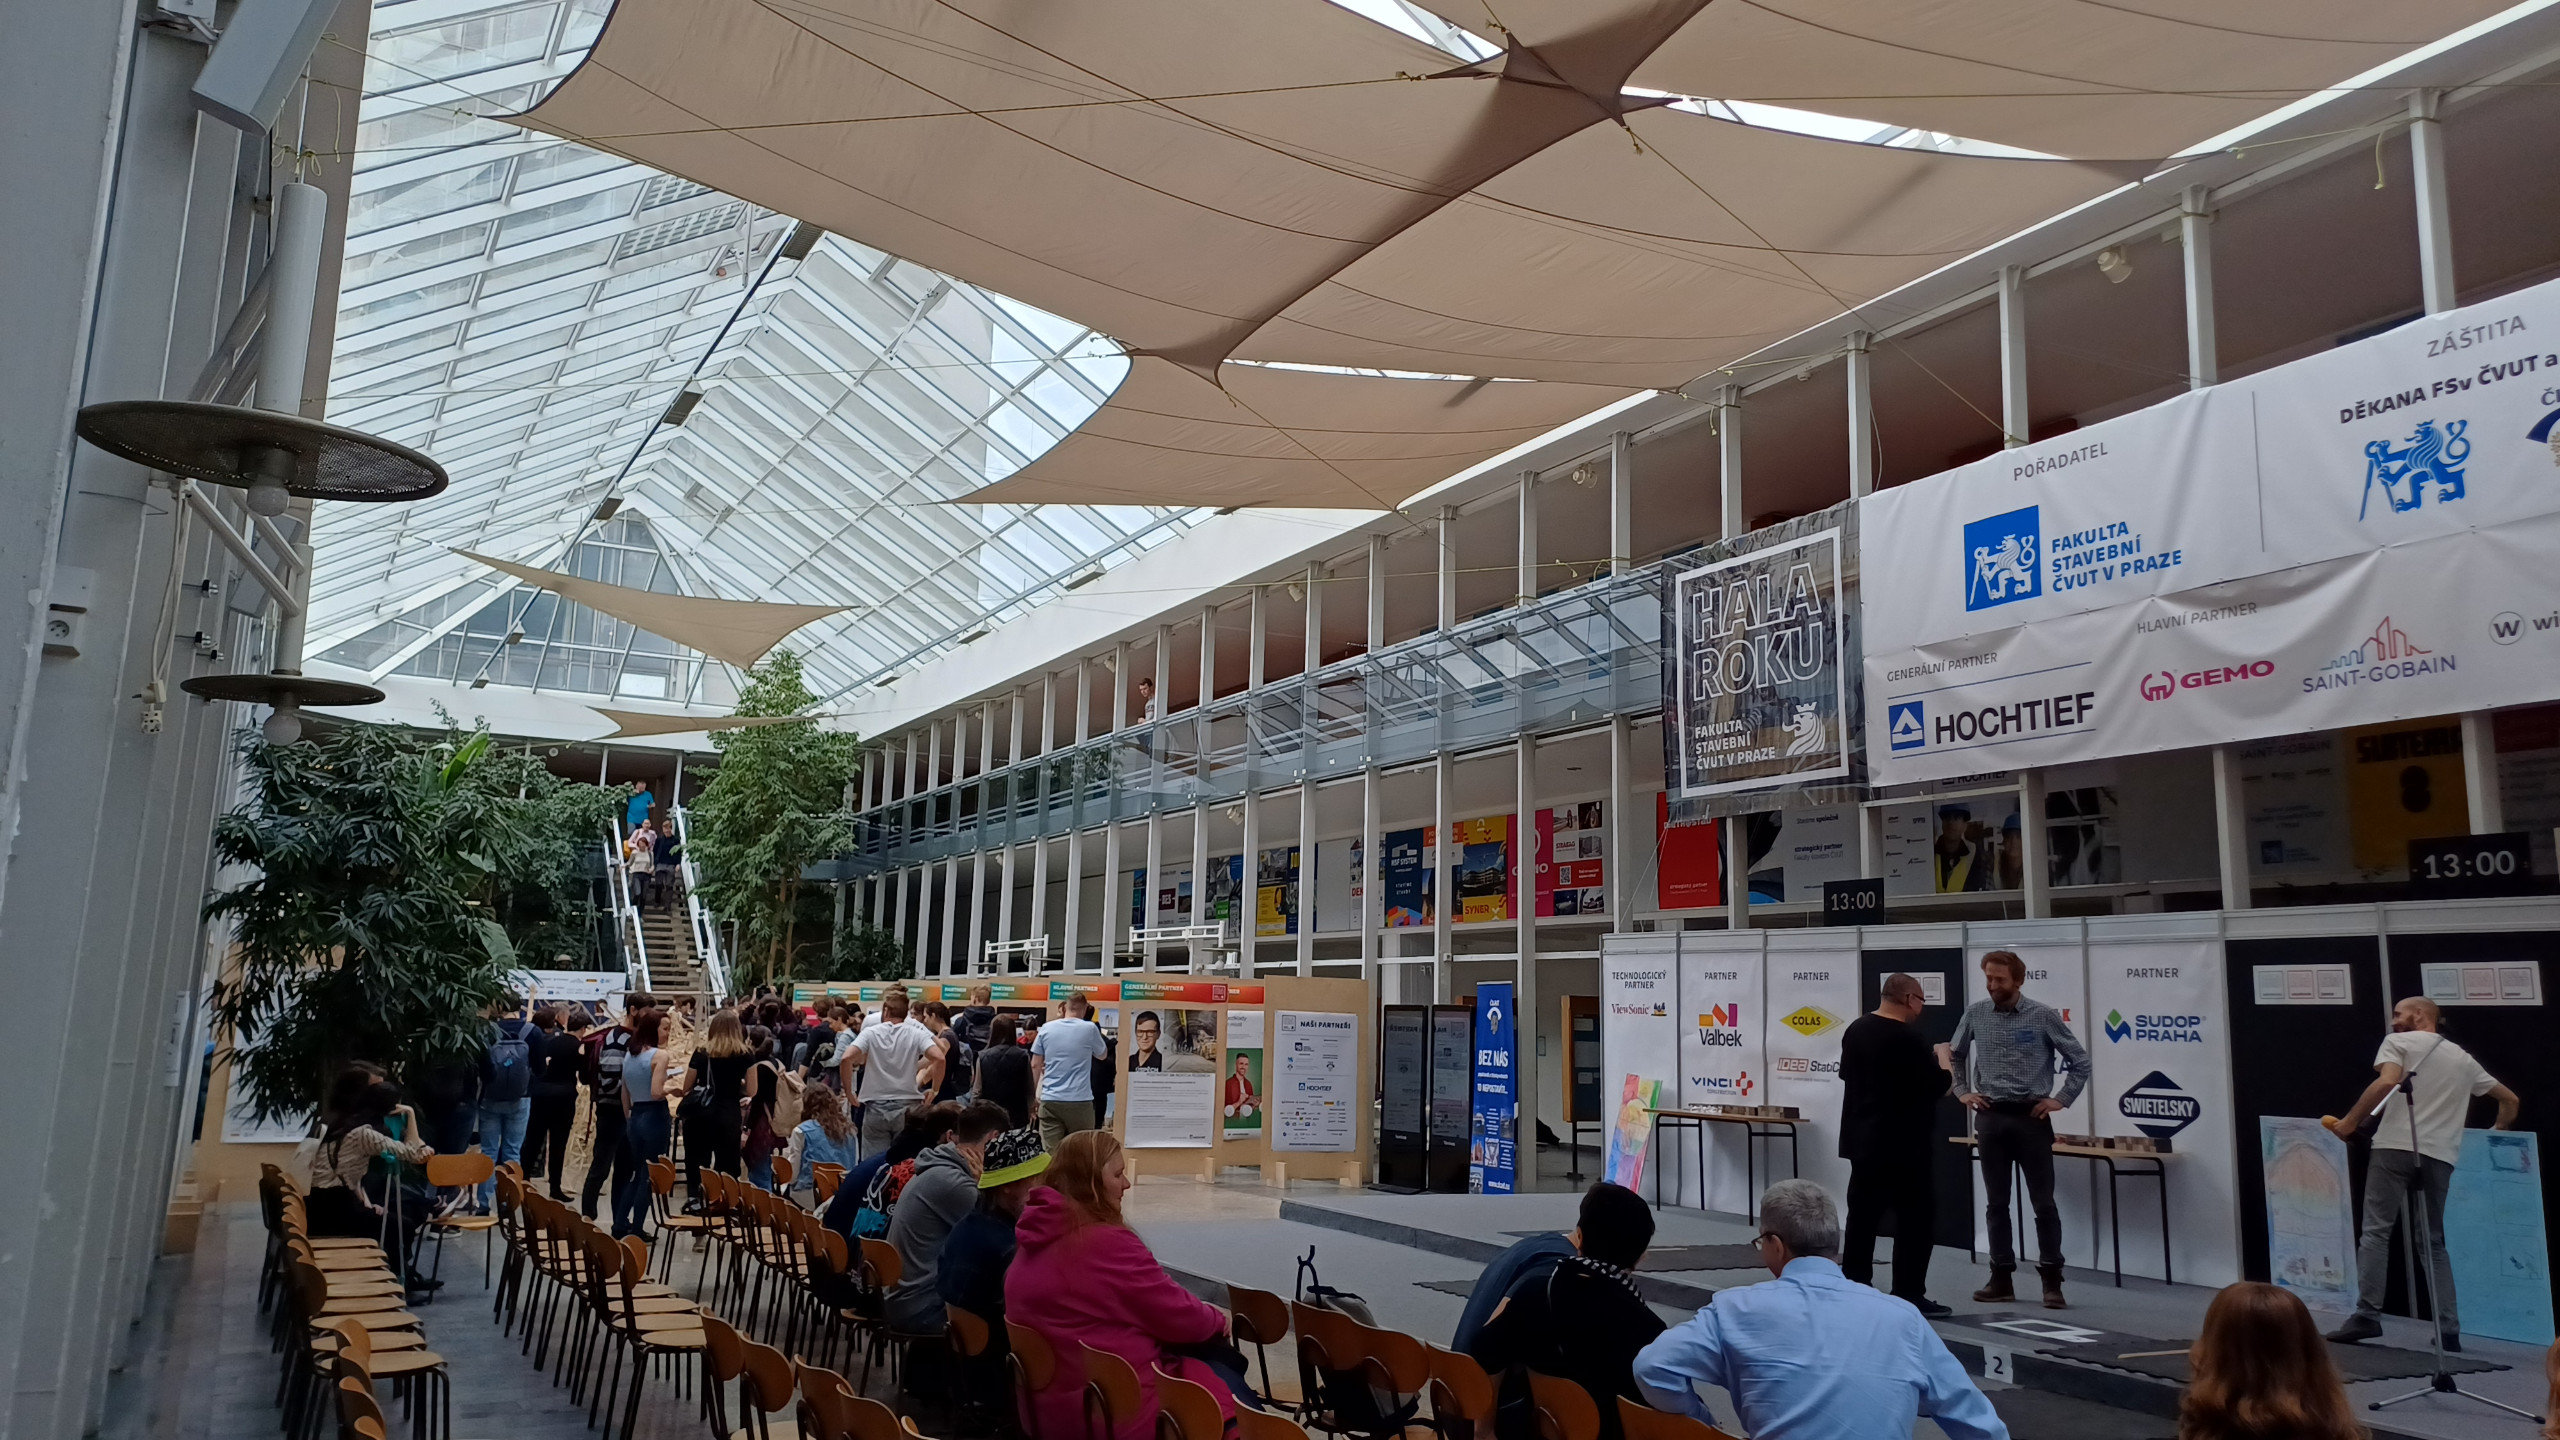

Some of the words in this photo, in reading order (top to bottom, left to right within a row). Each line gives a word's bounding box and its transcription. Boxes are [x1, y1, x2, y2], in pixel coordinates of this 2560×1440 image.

[2427, 315, 2526, 358] ZÁŠTITA
[2339, 385, 2427, 424] DĚKANA
[2431, 377, 2472, 400] FSv
[2477, 355, 2538, 385] ČVUT
[2543, 353, 2558, 367] a
[2013, 441, 2108, 481] POŘADATEL
[2051, 521, 2129, 553] FAKULTA
[2051, 533, 2142, 573] STAVEBNÍ
[2052, 567, 2098, 593] ČVUT
[2102, 566, 2114, 580] V
[2120, 549, 2182, 578] PRAZE
[1693, 562, 1823, 644] HALA
[2137, 611, 2187, 634] HLAVNÍ
[2190, 602, 2257, 625] PARTNER
[1693, 621, 1824, 701] ROKU
[1887, 660, 1946, 682] GENERÁLNÍ
[1948, 652, 1997, 672] PARTNER
[2180, 660, 2275, 689] GEMO
[2302, 655, 2457, 694] SAINT-GOBAIN
[1694, 718, 1743, 740] FAKULTA
[1935, 692, 2095, 745] HOCHTIEF
[1695, 730, 1751, 755] STAVEBNÍ
[1696, 753, 1727, 770] ČVUT
[1727, 753, 1736, 766] V
[1737, 746, 1776, 764] PRAZE
[2422, 849, 2516, 880] 13:00
[1464, 904, 1490, 915] SYNER
[1831, 890, 1876, 911] 13:00
[1611, 969, 1667, 980] TECHNOLOGICKÝ
[1704, 971, 1738, 980] PARTNER
[1793, 971, 1830, 981] PARTNER
[2126, 968, 2179, 979] PARTNER
[1124, 983, 1158, 991] GENERÁLNÍ
[1158, 984, 1185, 992] PARTNER
[1624, 980, 1655, 989] PARTNER
[1611, 1003, 1649, 1014] ViewSonic
[1300, 1020, 1317, 1029] NAŠI
[1318, 1020, 1351, 1030] PARTNEŘI
[1791, 1015, 1821, 1026] COLAS
[2135, 1015, 2201, 1028] SUDOP
[1698, 1028, 1742, 1047] Valbek
[2135, 1029, 2203, 1043] PRAHA
[1478, 1049, 1493, 1066] BEZ
[1493, 1046, 1509, 1067] NÁS
[1810, 1060, 1841, 1073] StatiC
[1691, 1076, 1732, 1088] VINCI
[2123, 1096, 2195, 1118] SWIETELSKY
[1993, 1356, 2004, 1375] 2
